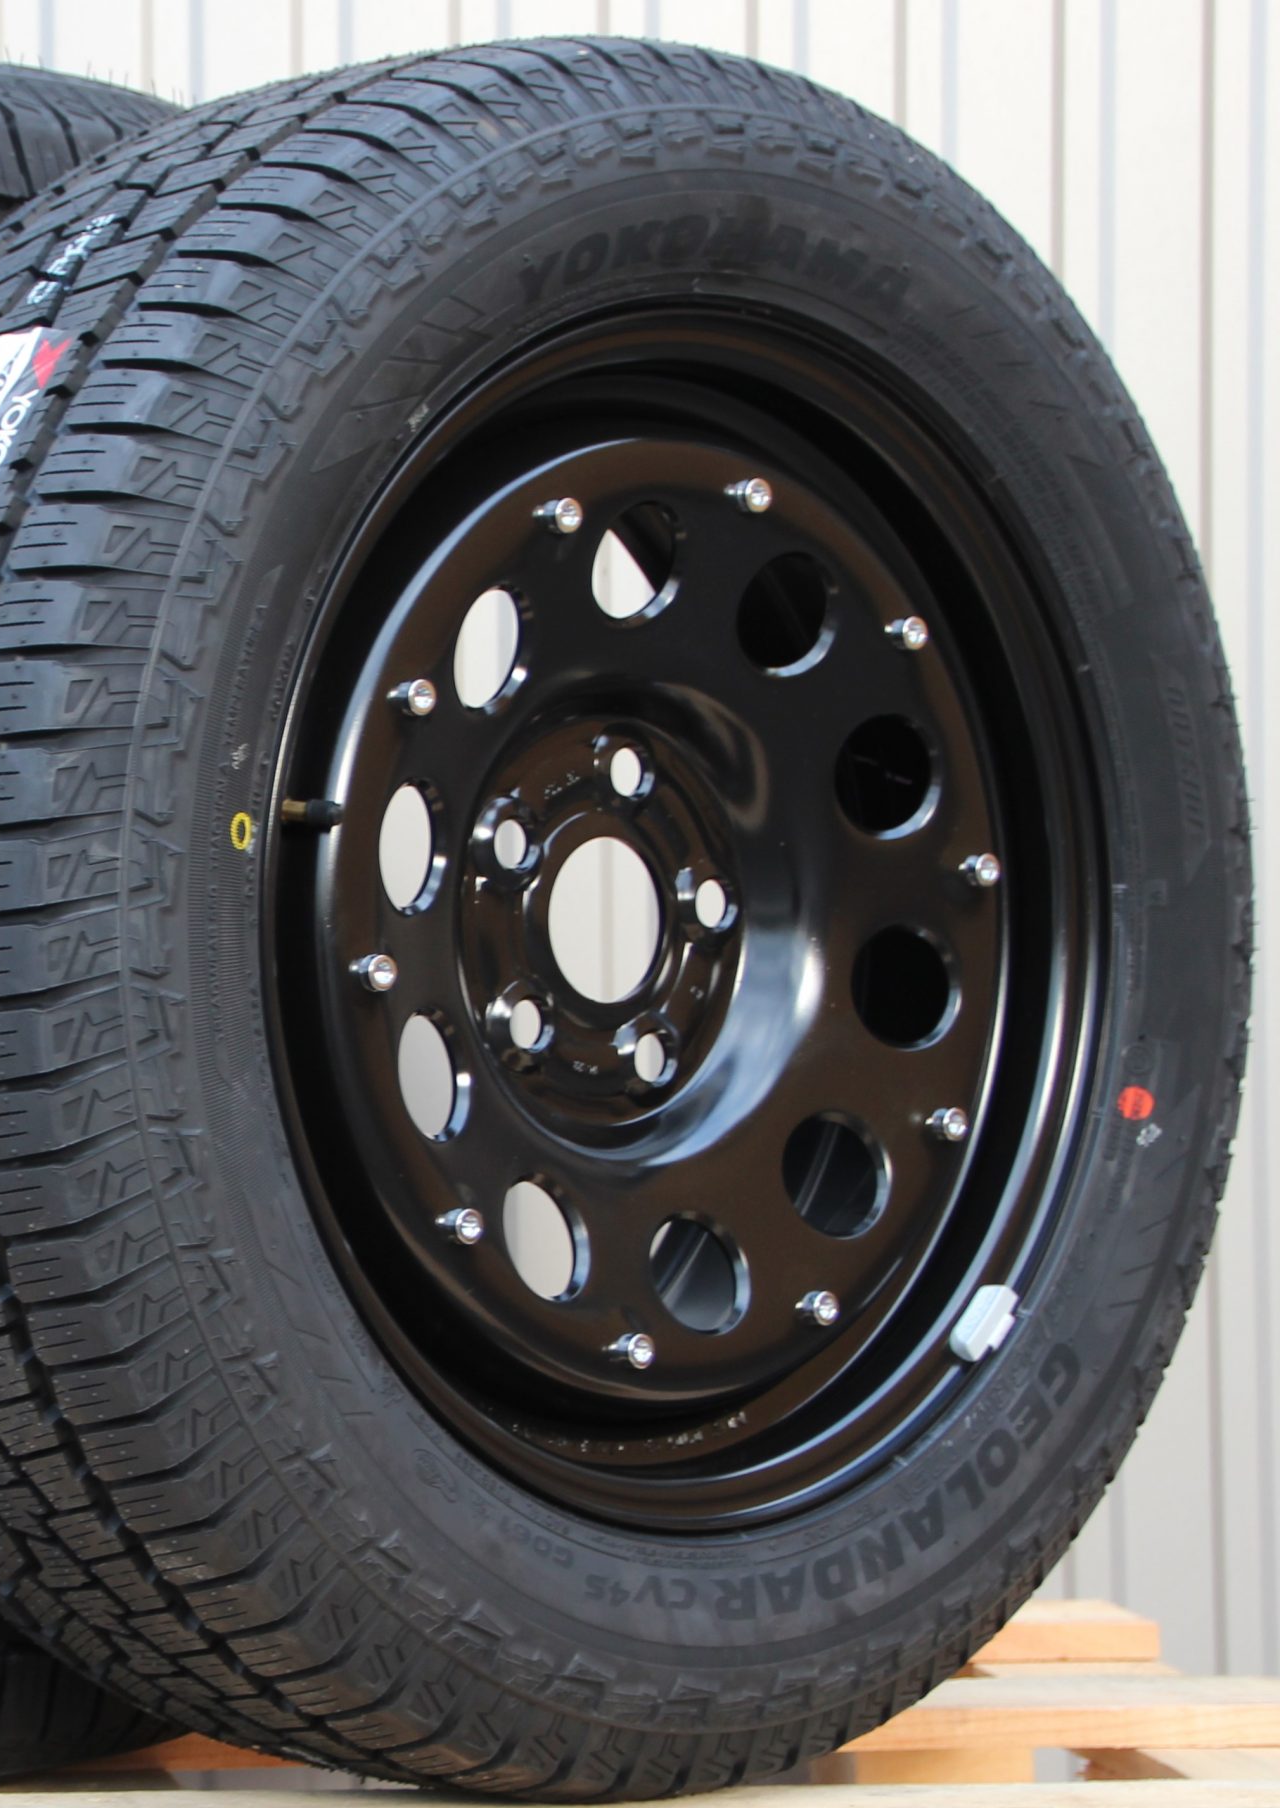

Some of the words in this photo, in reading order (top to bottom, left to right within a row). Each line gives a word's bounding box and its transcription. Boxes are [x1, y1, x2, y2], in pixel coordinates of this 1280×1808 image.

[517, 212, 911, 300] YOKOHAMA
[711, 1341, 1080, 1621] GEOLANDAR
[584, 1573, 697, 1610] CV4S
